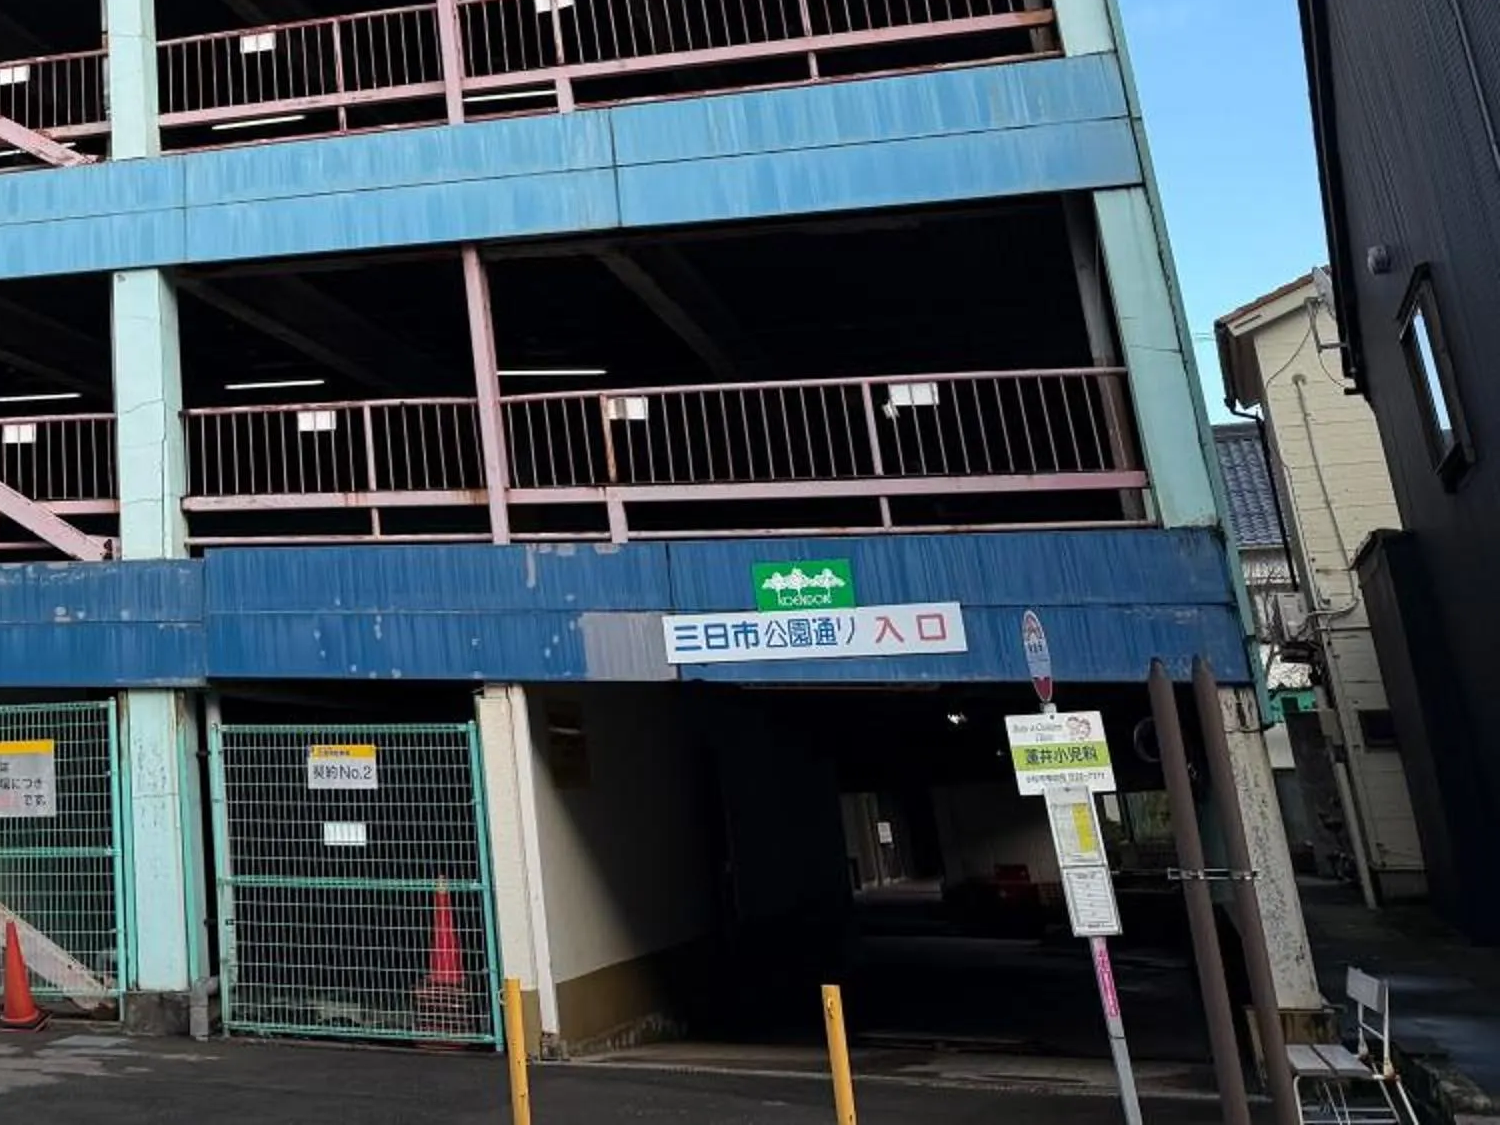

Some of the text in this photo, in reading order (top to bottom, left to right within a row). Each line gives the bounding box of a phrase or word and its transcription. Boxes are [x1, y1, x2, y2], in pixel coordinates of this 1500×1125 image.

[673, 613, 947, 651] 三日市公園通り 入口
